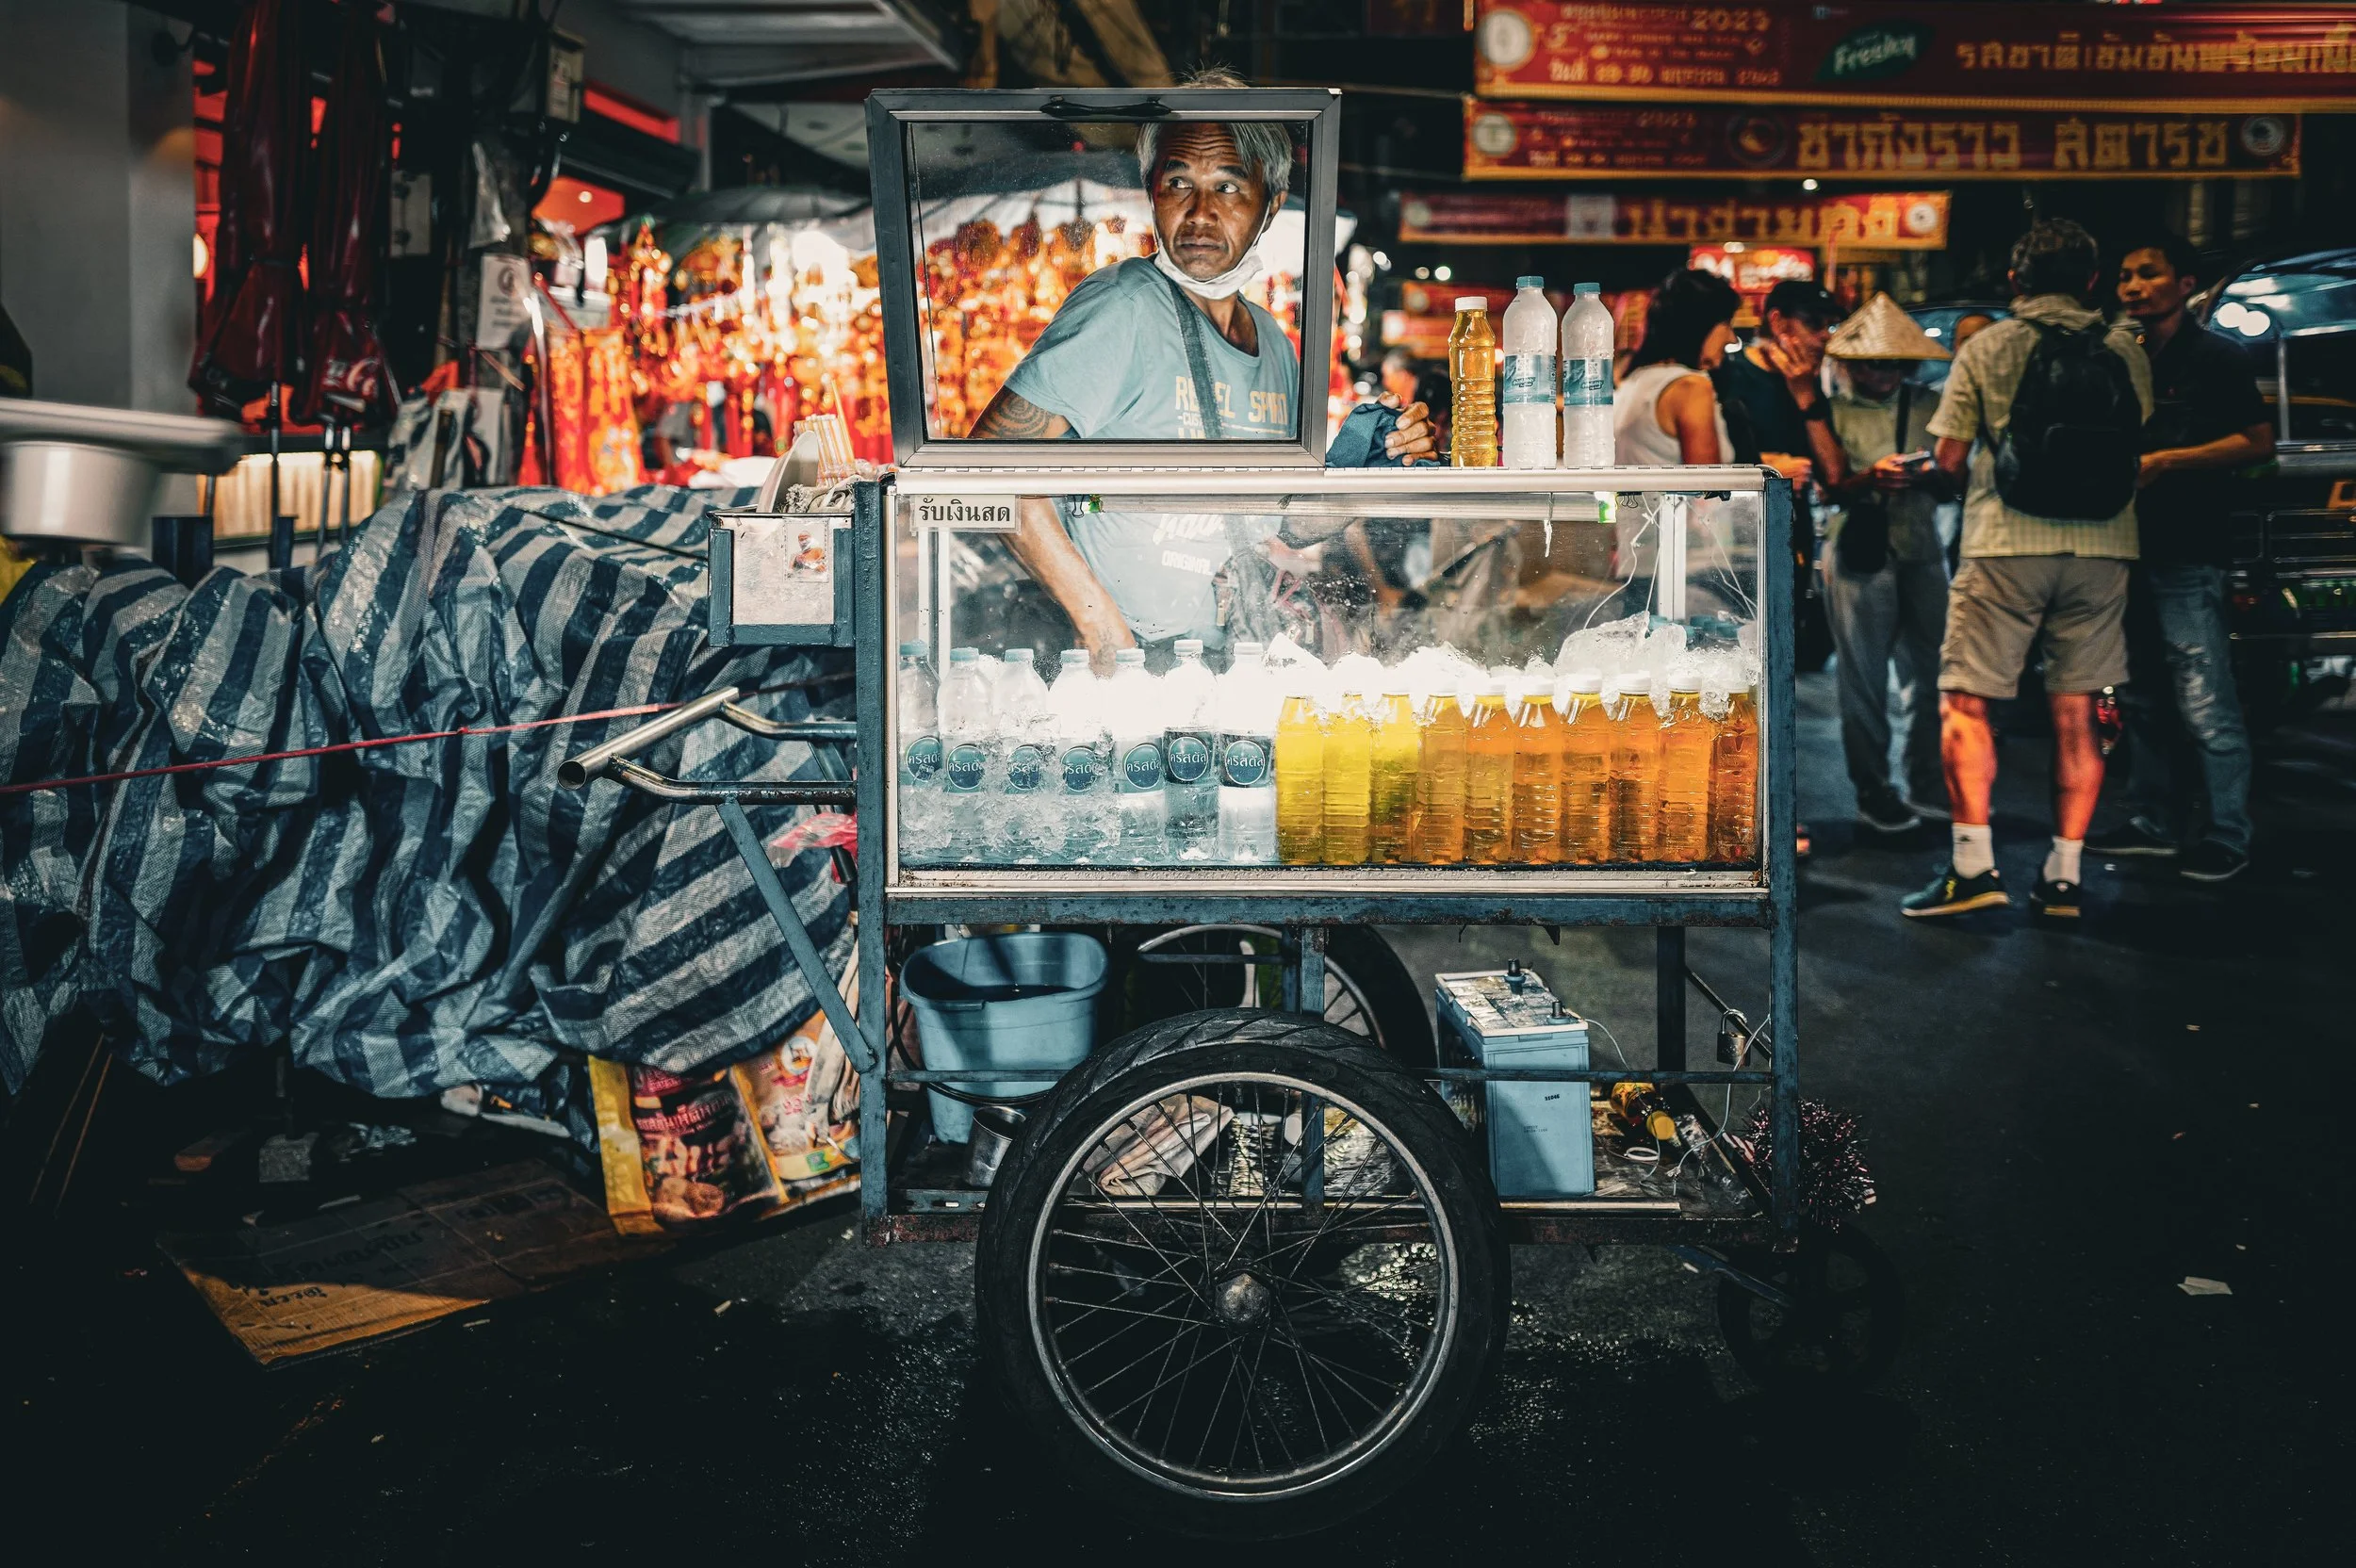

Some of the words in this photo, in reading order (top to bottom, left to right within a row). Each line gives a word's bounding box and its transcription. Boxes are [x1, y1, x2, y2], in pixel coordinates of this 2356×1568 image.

[1175, 375, 1236, 418] REEL
[919, 497, 1010, 522] รับเงินสด
[1170, 751, 1206, 765] คริสตัล
[1227, 755, 1264, 770] คริสตัล
